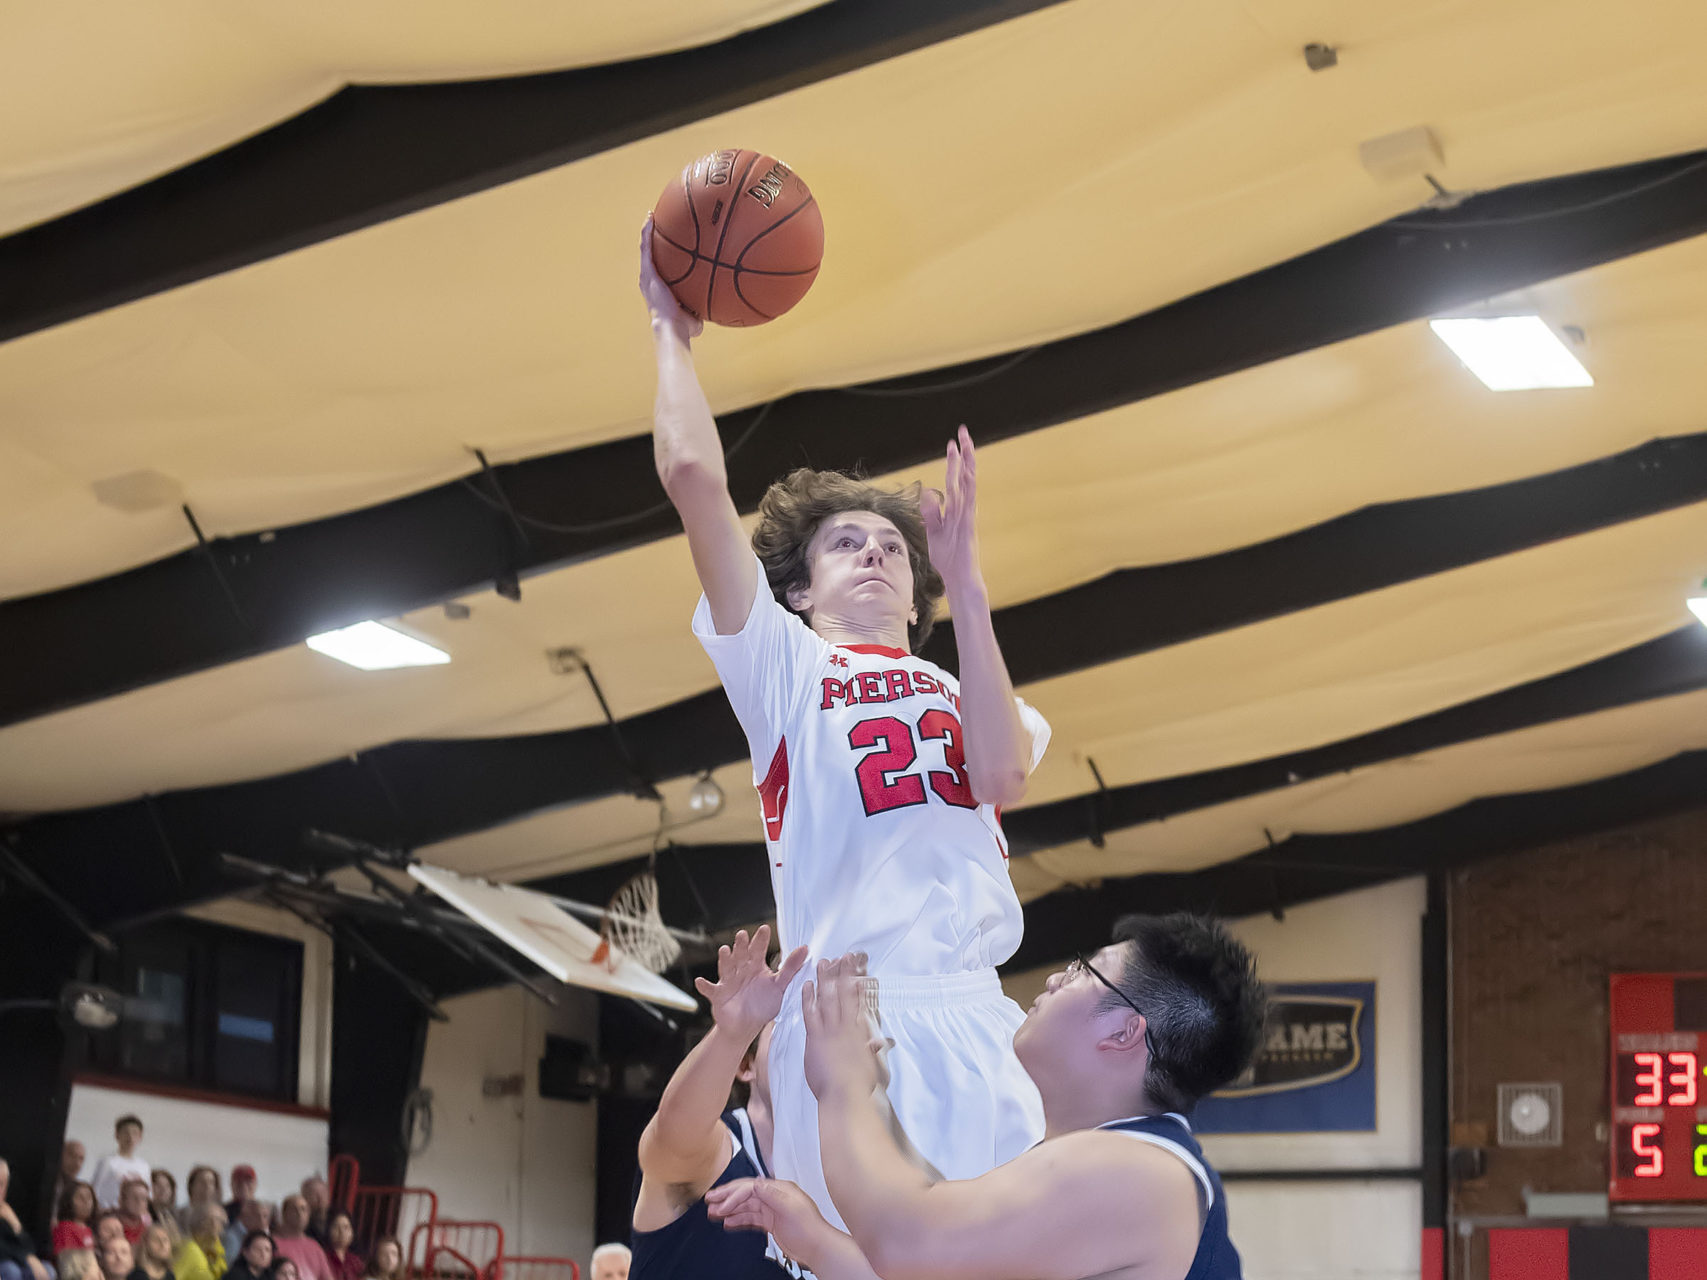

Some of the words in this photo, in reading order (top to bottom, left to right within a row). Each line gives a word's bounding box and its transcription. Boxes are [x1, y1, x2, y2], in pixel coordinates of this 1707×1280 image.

[848, 708, 980, 817] 23
[1634, 1053, 1697, 1106] 33
[1632, 1124, 1664, 1177] 5
